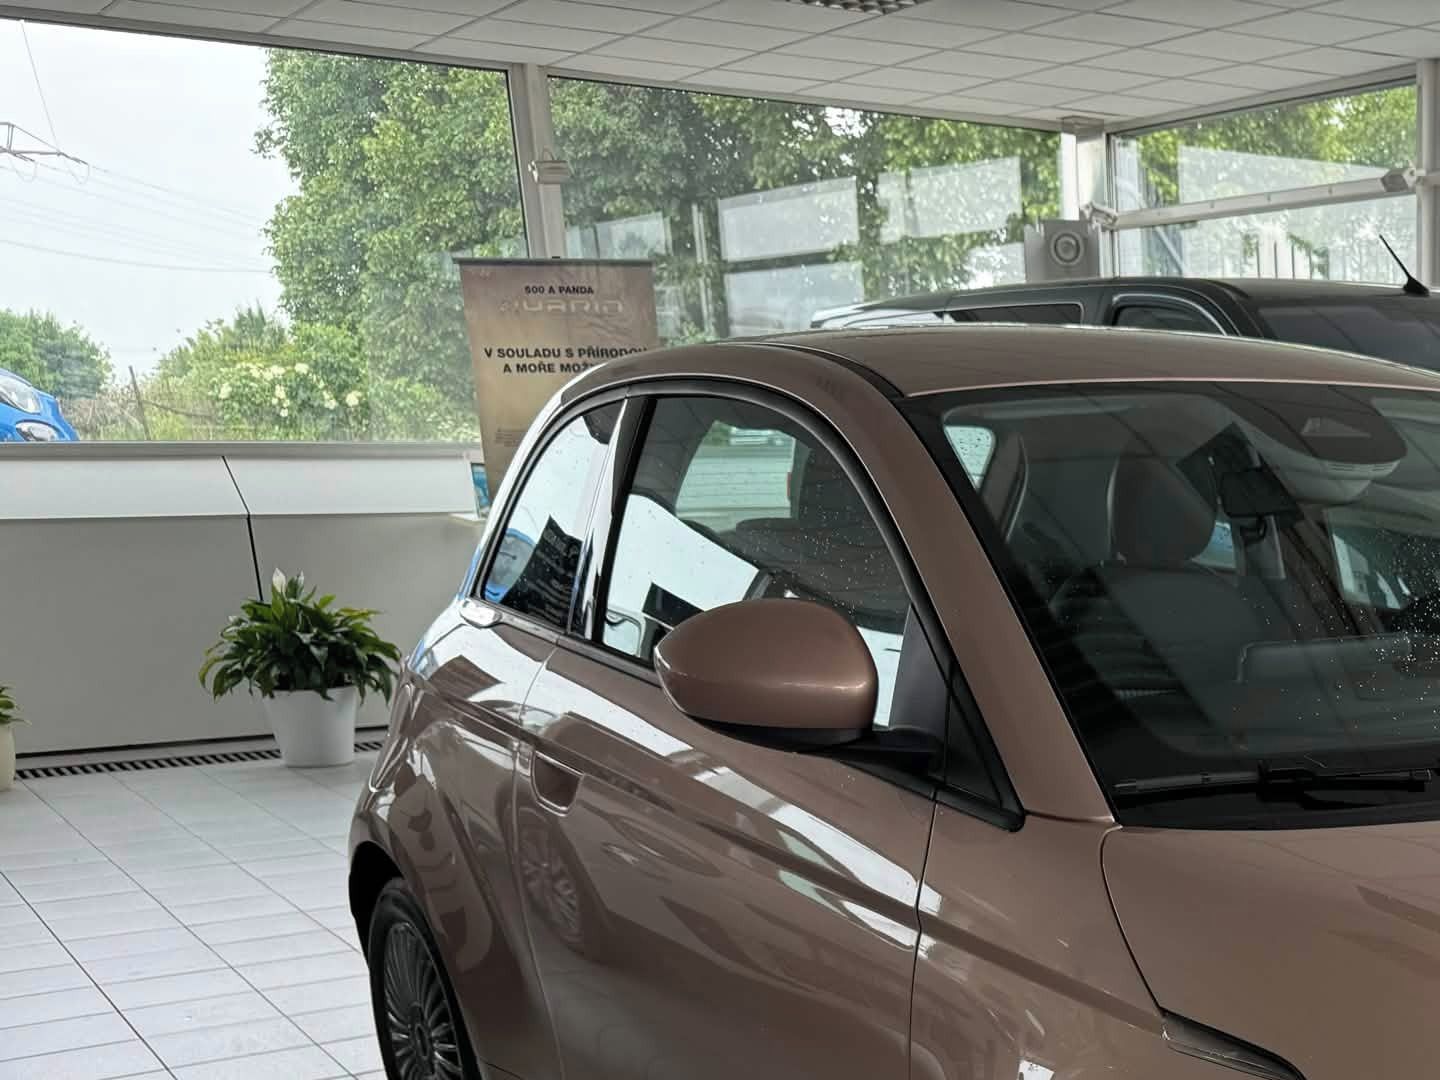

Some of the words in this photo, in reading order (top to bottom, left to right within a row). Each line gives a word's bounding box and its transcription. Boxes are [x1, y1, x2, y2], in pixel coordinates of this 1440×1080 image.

[524, 285, 545, 295] 500
[548, 286, 556, 294] A
[558, 285, 594, 295] PANDA
[484, 347, 493, 358] V
[497, 347, 560, 358] SOULADU
[565, 347, 574, 358] S
[503, 363, 512, 373] A
[516, 361, 557, 373] MOŘE
